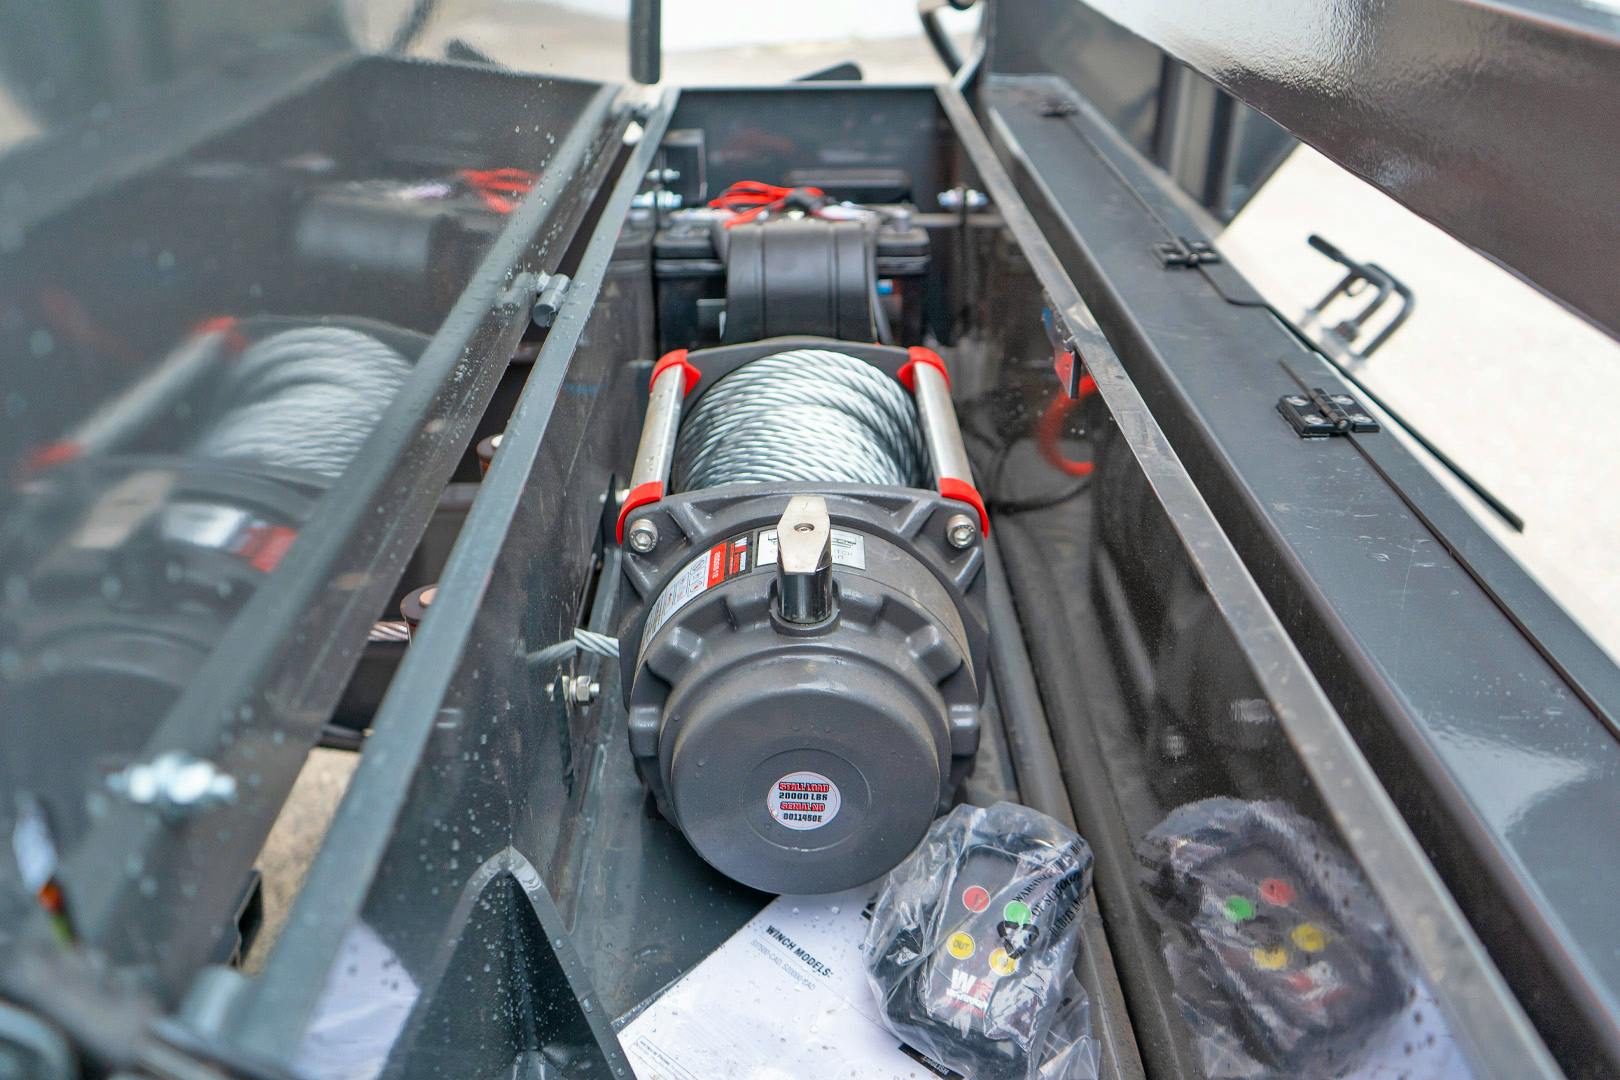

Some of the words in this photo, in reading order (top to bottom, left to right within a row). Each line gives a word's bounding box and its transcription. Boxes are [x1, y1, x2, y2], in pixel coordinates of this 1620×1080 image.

[779, 792, 809, 800] 20000
[811, 793, 828, 801] LBS
[780, 802, 811, 811] SERIAL
[952, 939, 970, 952] OUT
[766, 925, 797, 951] WINCH
[794, 947, 834, 978] MODELS:
